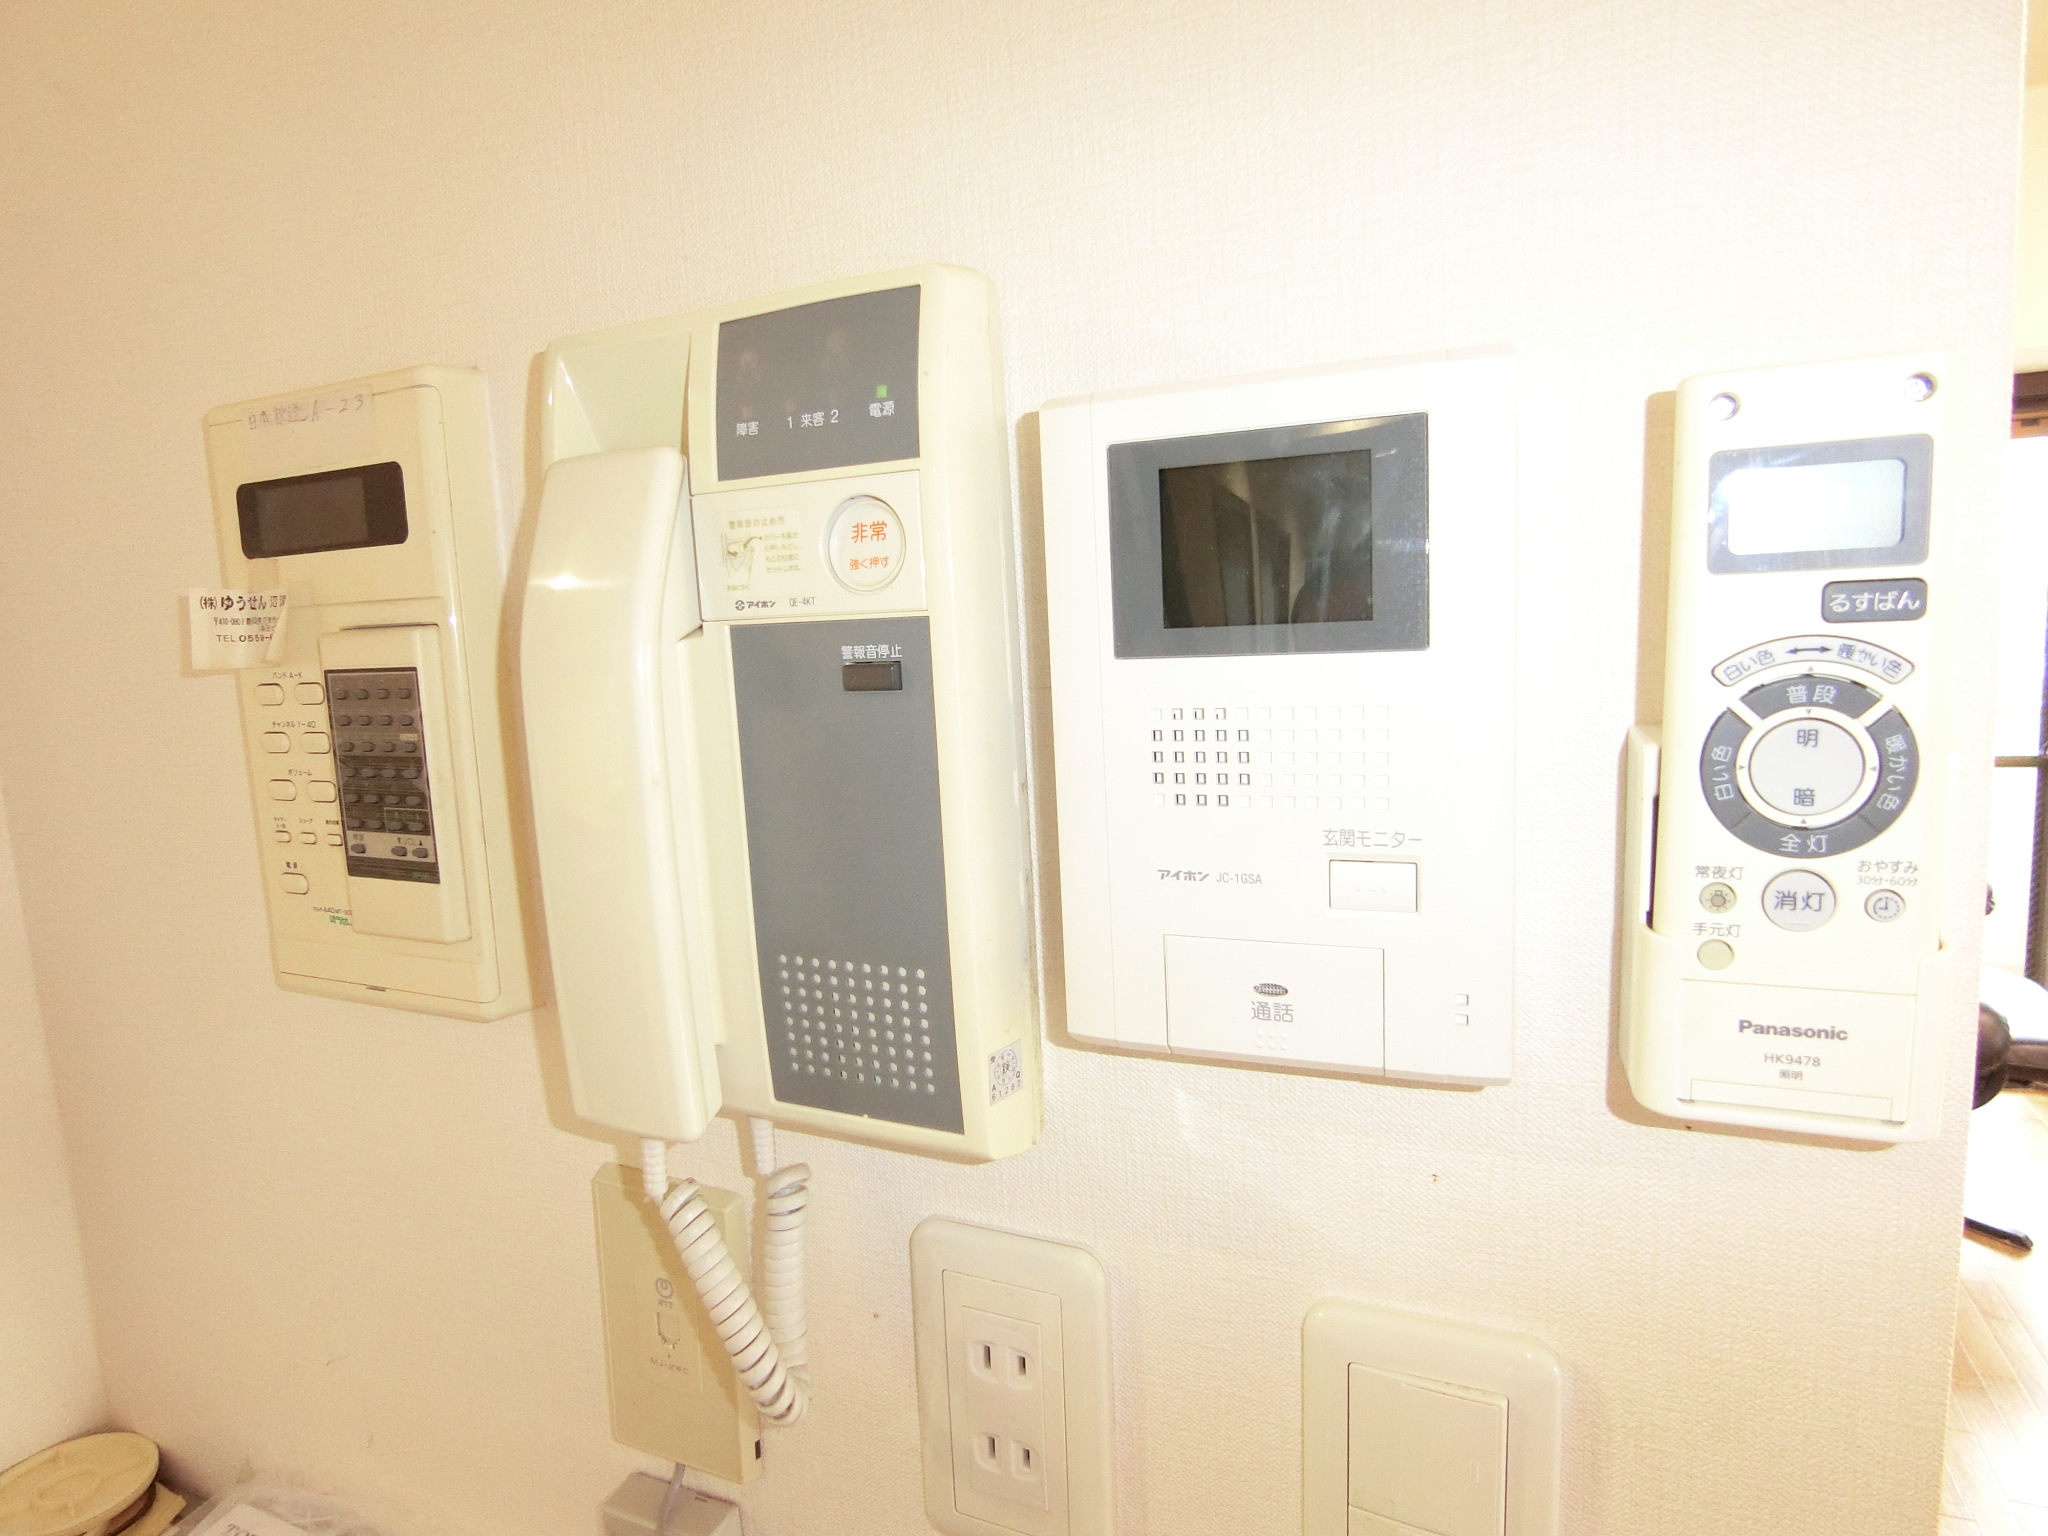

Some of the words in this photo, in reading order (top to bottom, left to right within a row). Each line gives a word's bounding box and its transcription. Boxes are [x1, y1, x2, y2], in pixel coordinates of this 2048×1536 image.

[787, 416, 793, 429] 1
[800, 411, 825, 428] 来客
[830, 409, 839, 424] 2
[869, 401, 895, 418] 電源
[736, 421, 760, 437] 障害
[851, 520, 888, 544] 非常
[849, 556, 890, 571] 強く押す
[746, 600, 776, 609] アイホン
[789, 596, 815, 607] QE-4KT
[1828, 590, 1920, 612] るすばん
[216, 634, 236, 643] TEL
[841, 643, 903, 661] 警報音停止
[1837, 643, 1902, 679] 暖かい色
[1723, 649, 1776, 682] 白い色
[1786, 684, 1837, 705] 普段
[1796, 729, 1819, 748] 明
[1710, 744, 1735, 802] 白い色
[1876, 733, 1910, 812] 暖かい色
[1793, 787, 1816, 807] 暗
[1322, 828, 1423, 849] 玄関モニター
[1779, 832, 1828, 854] 全灯
[1695, 865, 1743, 881] 常夜灯
[1857, 859, 1919, 875] おやすみ
[1157, 869, 1211, 883] アイホン
[1215, 871, 1263, 886] JC-1GSA
[1773, 890, 1825, 912] 消灯
[1692, 921, 1742, 938] 手元灯
[1251, 1001, 1295, 1024] 通話
[1738, 1019, 1849, 1042] Panasonic
[1763, 1053, 1821, 1068] HK9478
[1779, 1069, 1804, 1081] 照明
